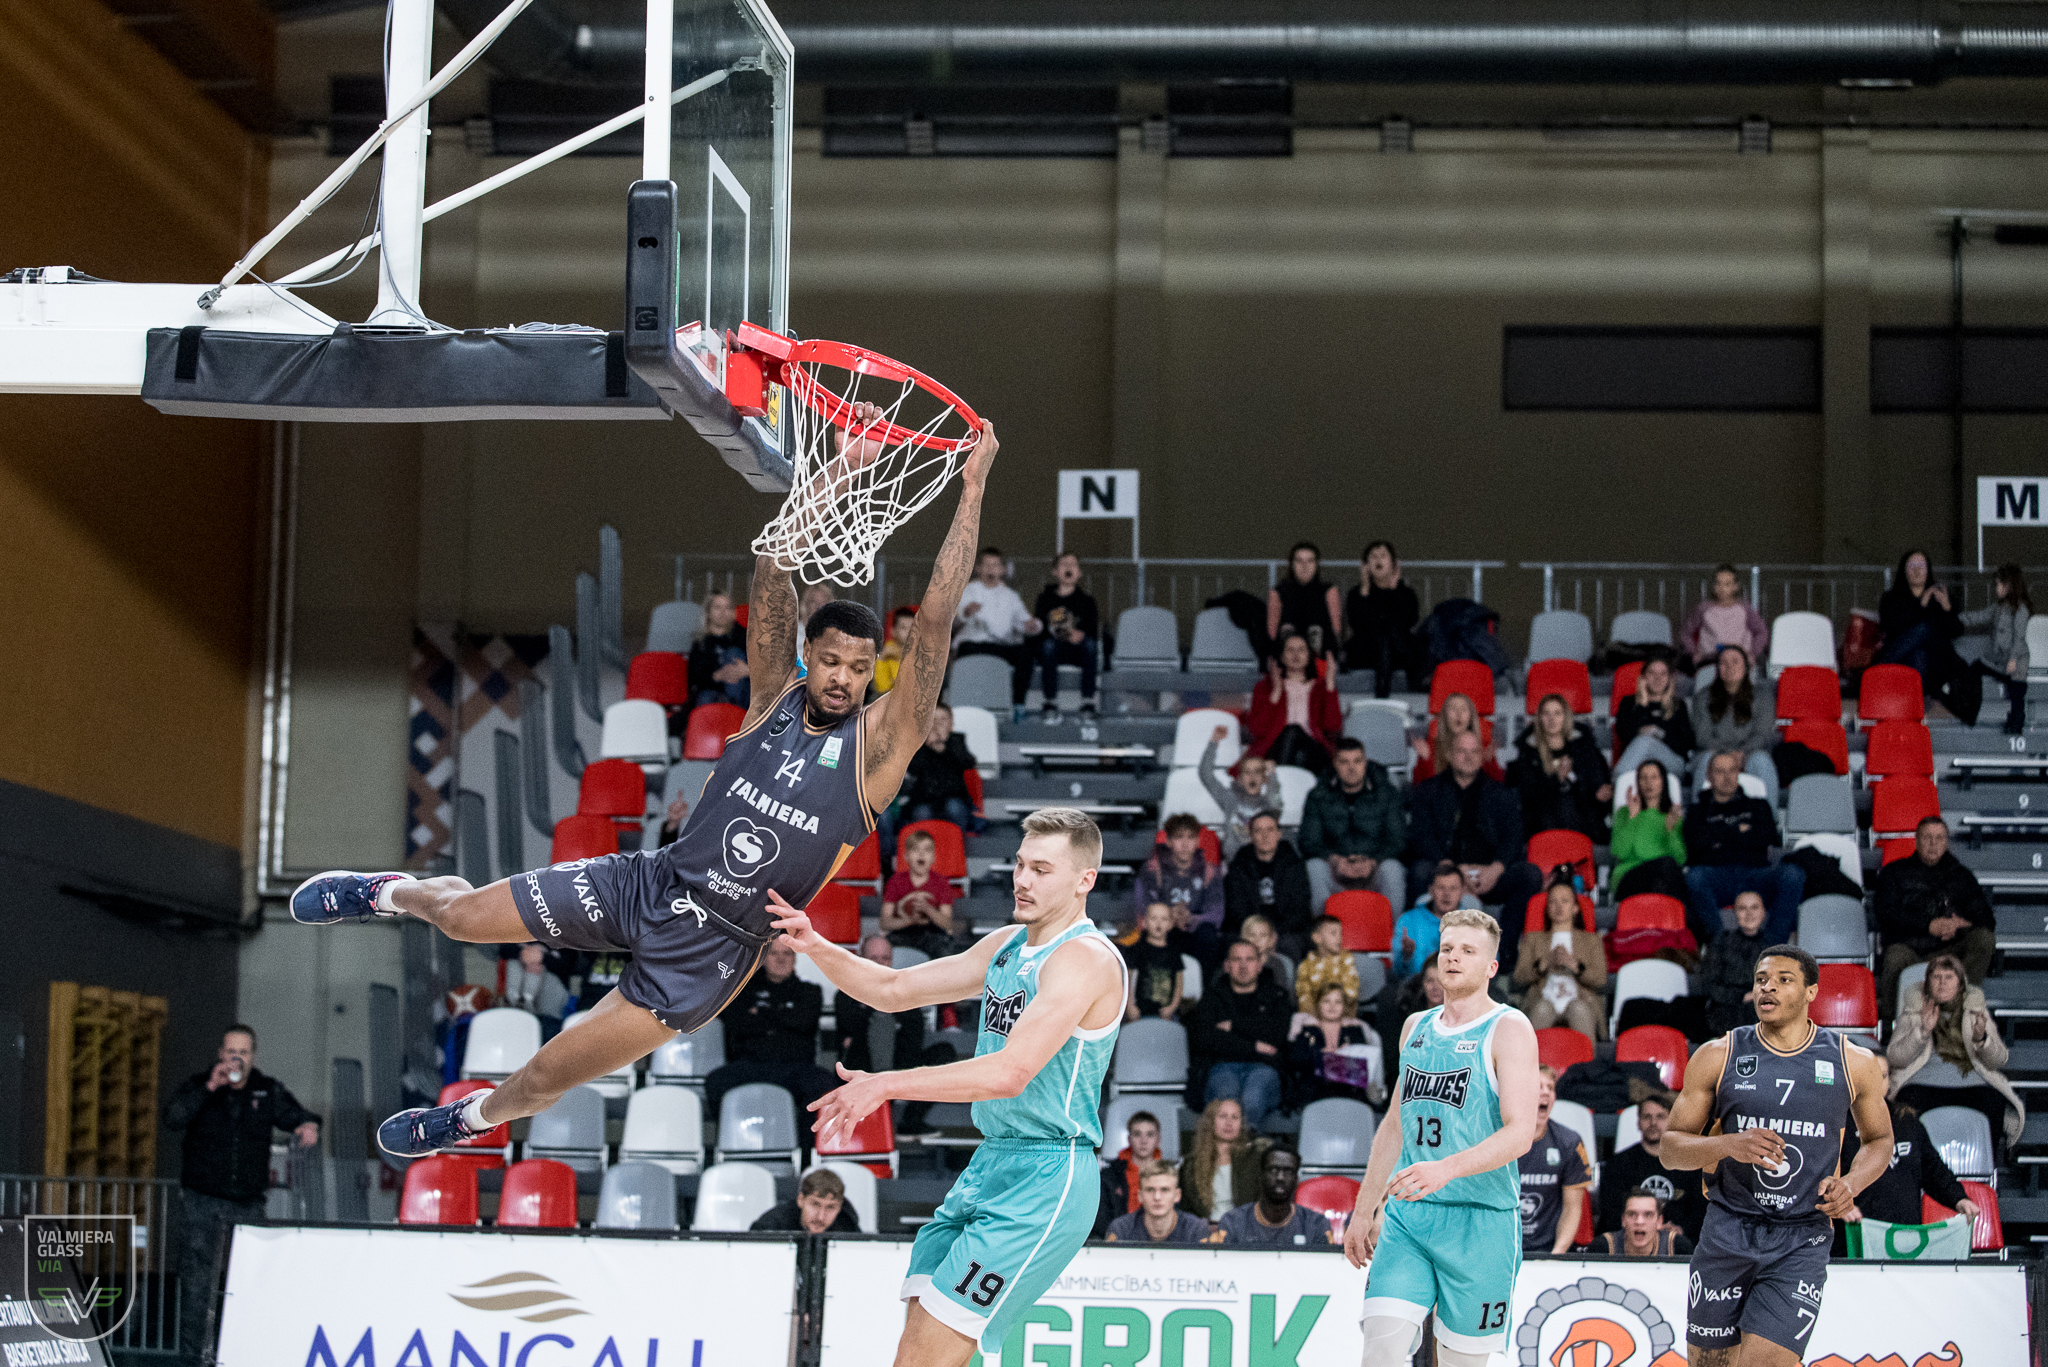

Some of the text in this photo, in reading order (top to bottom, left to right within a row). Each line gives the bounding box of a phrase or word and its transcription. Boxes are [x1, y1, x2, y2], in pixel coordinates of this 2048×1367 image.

[1081, 476, 1116, 512] N
[1996, 484, 2039, 520] M
[2009, 737, 2026, 751] 10
[2018, 793, 2029, 809] 9
[2032, 853, 2043, 869] 8
[572, 871, 603, 922] VAKS
[707, 881, 740, 901] GLASS
[1401, 1064, 1471, 1110] WOLVES
[1775, 1078, 1795, 1106] 7
[1416, 1116, 1442, 1147] 13
[1736, 1114, 1826, 1138] VALMIERA
[952, 1259, 1006, 1308] 19
[1048, 1274, 1238, 1294] AIMNIECĪBAS TEHNIKA
[1704, 1286, 1743, 1302] VAKS
[1478, 1301, 1507, 1330] 13
[1794, 1307, 1816, 1340] 7
